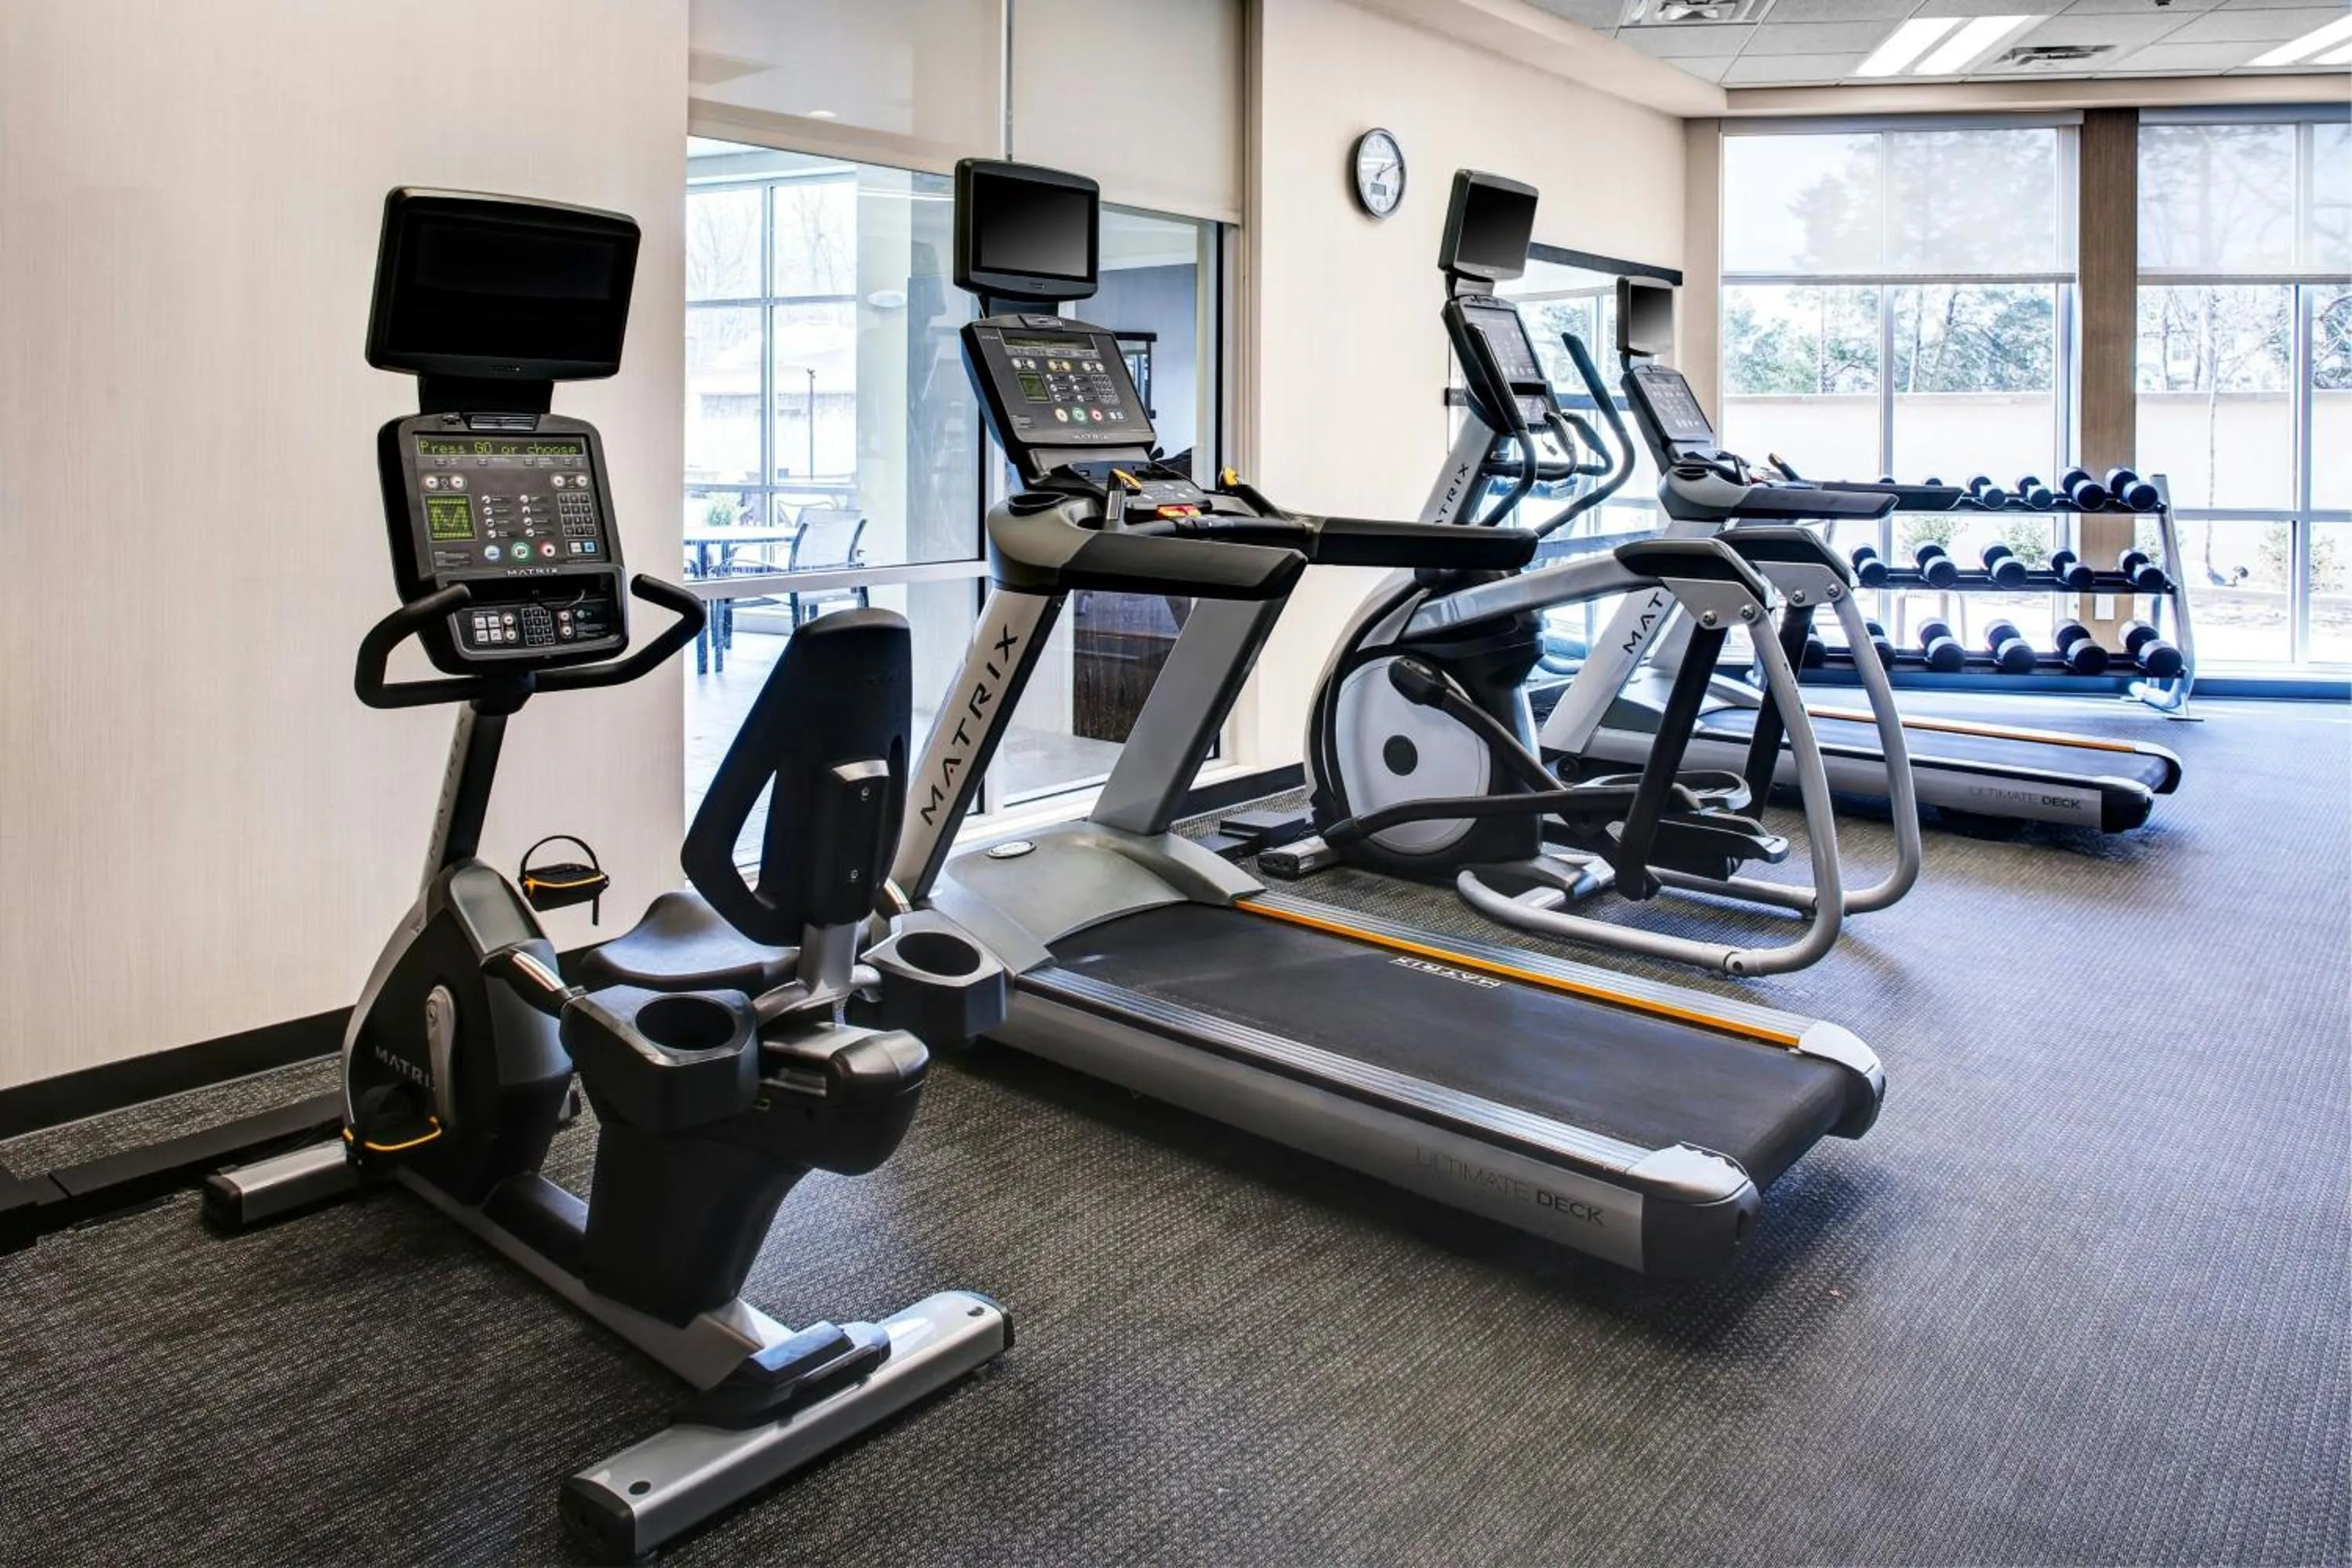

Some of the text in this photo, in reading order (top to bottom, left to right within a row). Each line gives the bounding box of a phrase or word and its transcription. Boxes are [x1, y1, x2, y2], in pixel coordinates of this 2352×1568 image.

[526, 441, 578, 456] choose
[1434, 463, 1468, 524] TRIX
[507, 567, 559, 576] MATRIX
[1623, 592, 1664, 655] MAT
[920, 623, 1018, 826] MATRIX
[2042, 795, 2082, 810] DECK
[1417, 1145, 1605, 1227] ULTIMATE DECK
